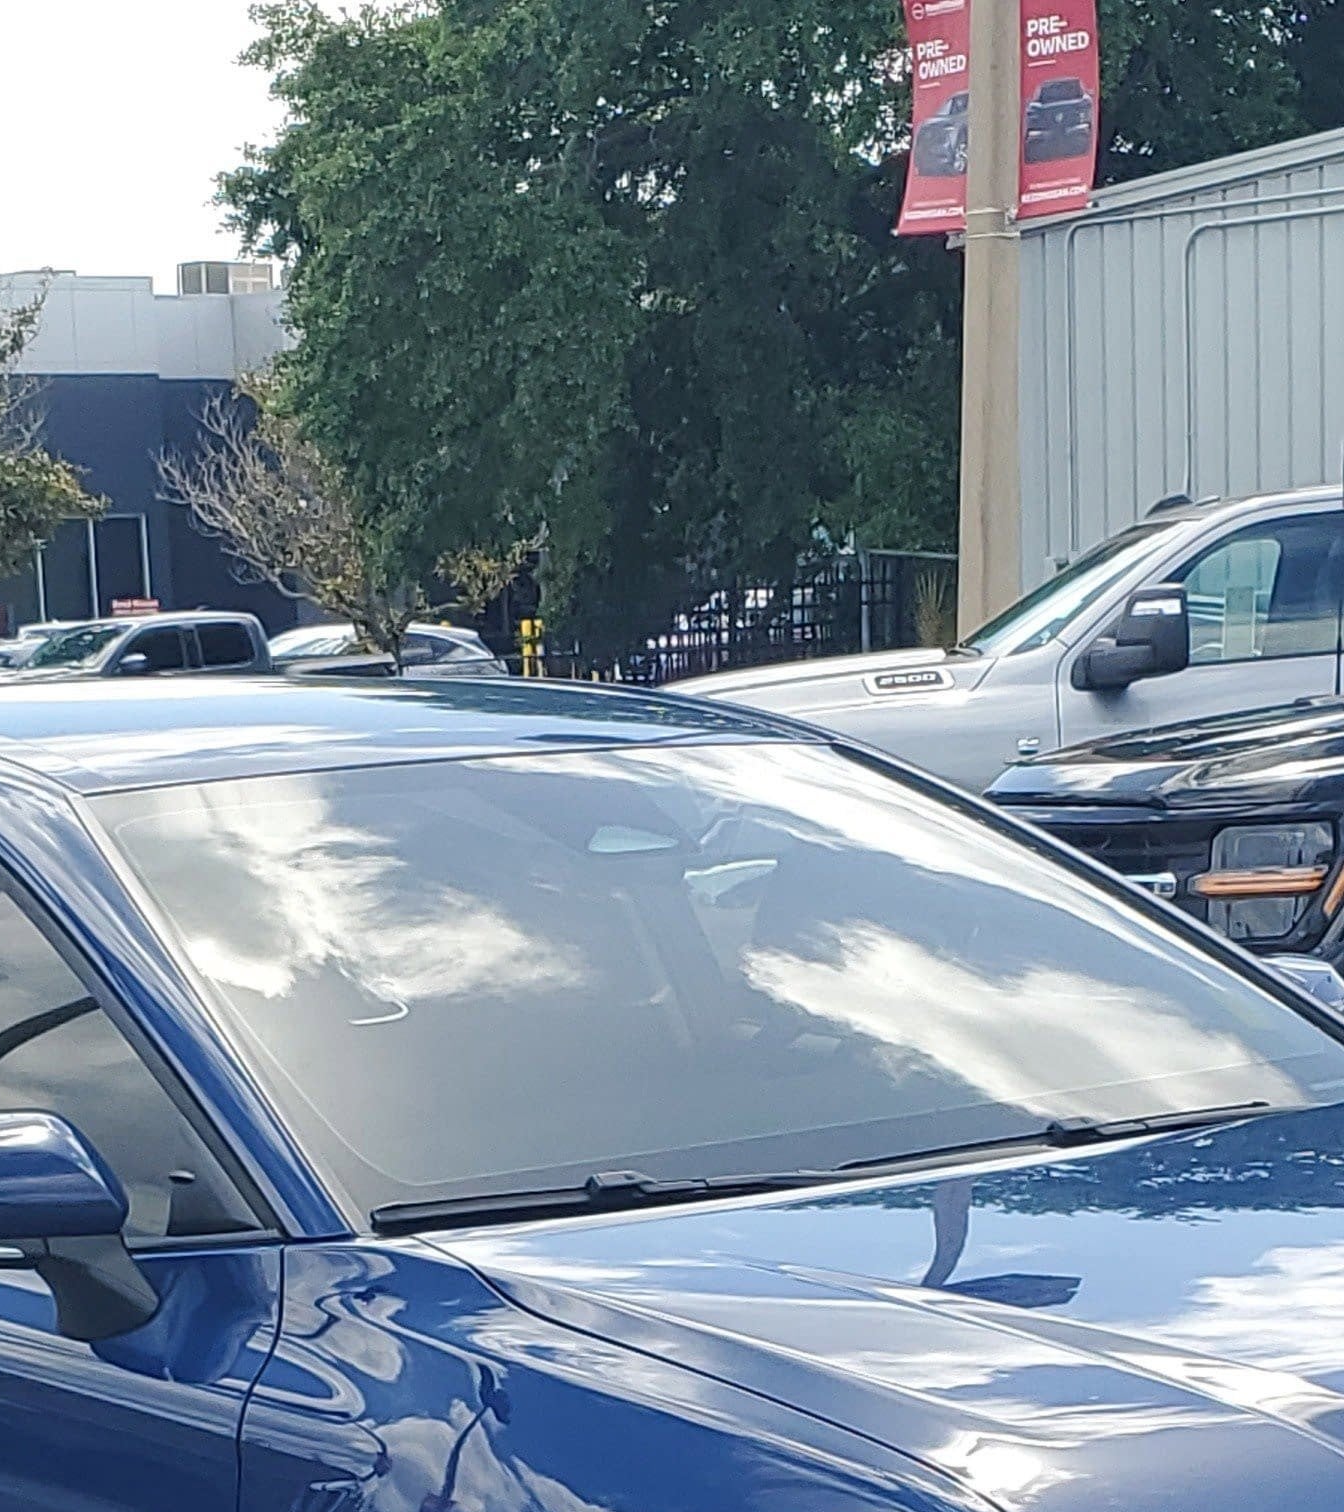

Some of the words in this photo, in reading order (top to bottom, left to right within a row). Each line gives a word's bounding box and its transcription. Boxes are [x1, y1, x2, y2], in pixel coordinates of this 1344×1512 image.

[1027, 16, 1067, 37] PRE-
[917, 40, 949, 60] PRE-
[1027, 31, 1089, 57] OWNED
[919, 55, 966, 79] OWNED
